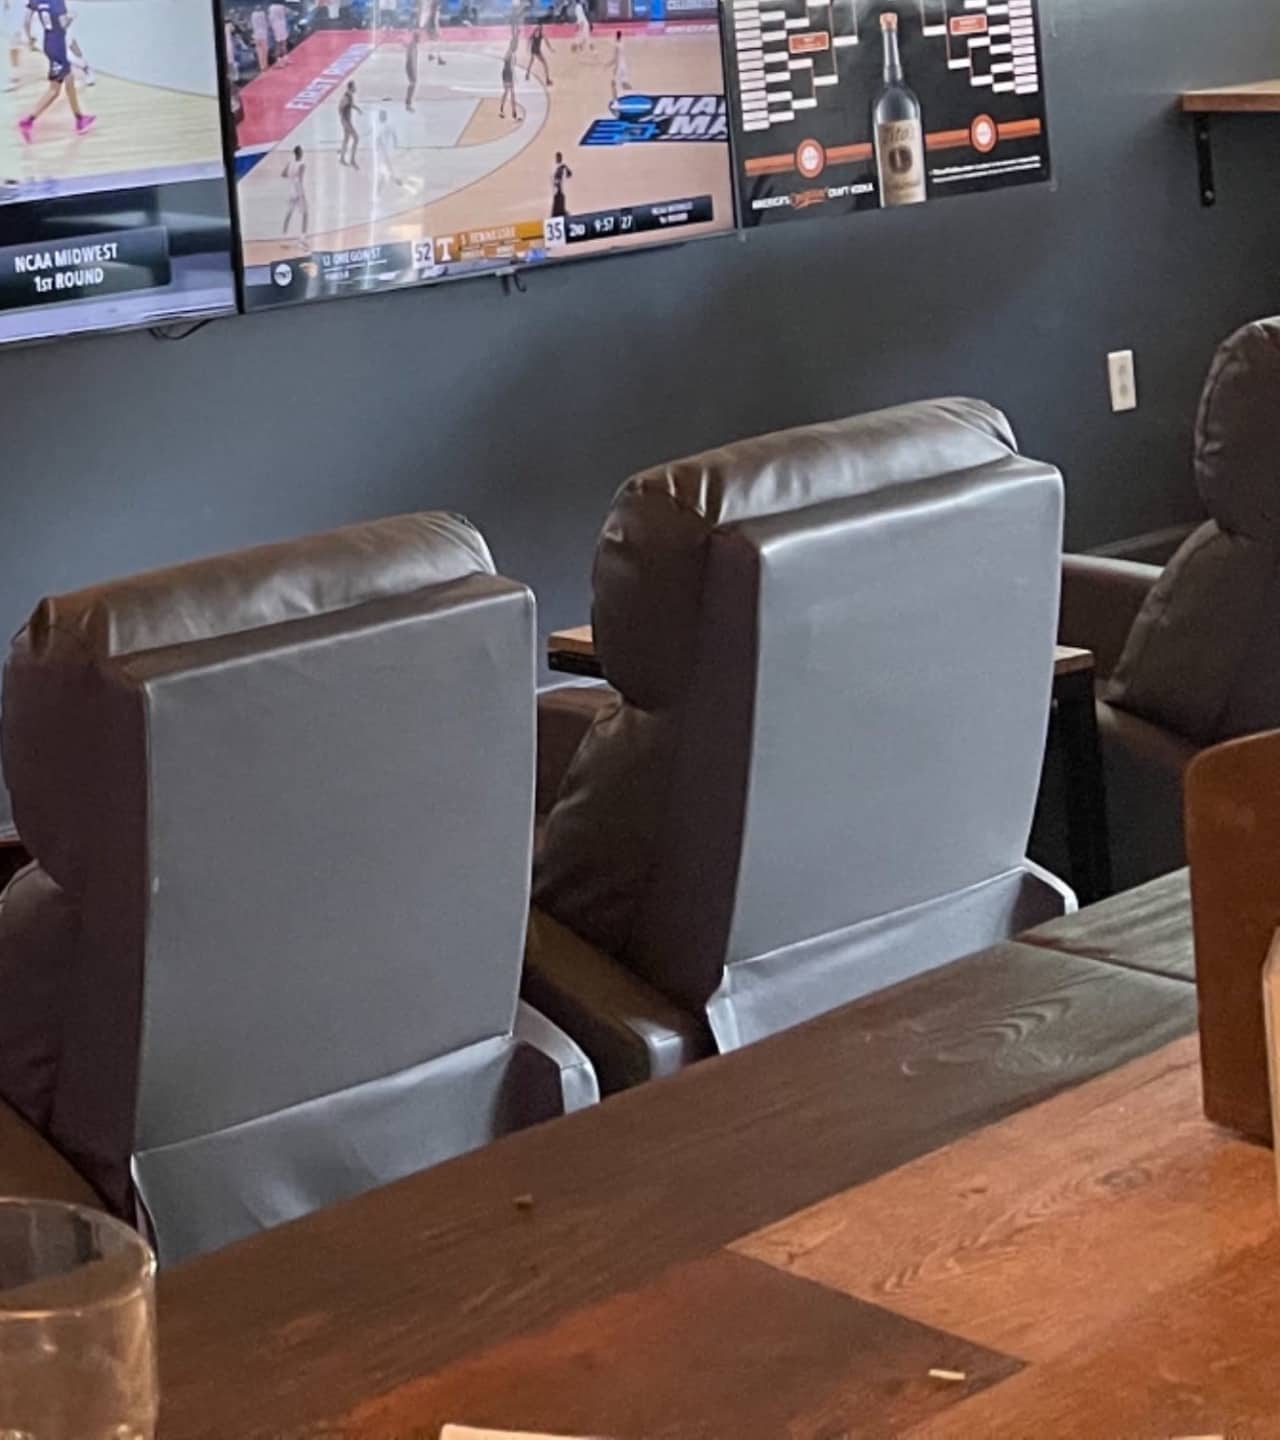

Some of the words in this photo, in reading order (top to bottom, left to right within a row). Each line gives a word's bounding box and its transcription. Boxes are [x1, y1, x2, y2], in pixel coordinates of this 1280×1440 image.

[546, 224, 563, 241] 35
[14, 251, 53, 273] NCAA
[54, 242, 118, 266] MIDWEST
[415, 243, 432, 262] 52
[54, 267, 104, 288] ROUND
